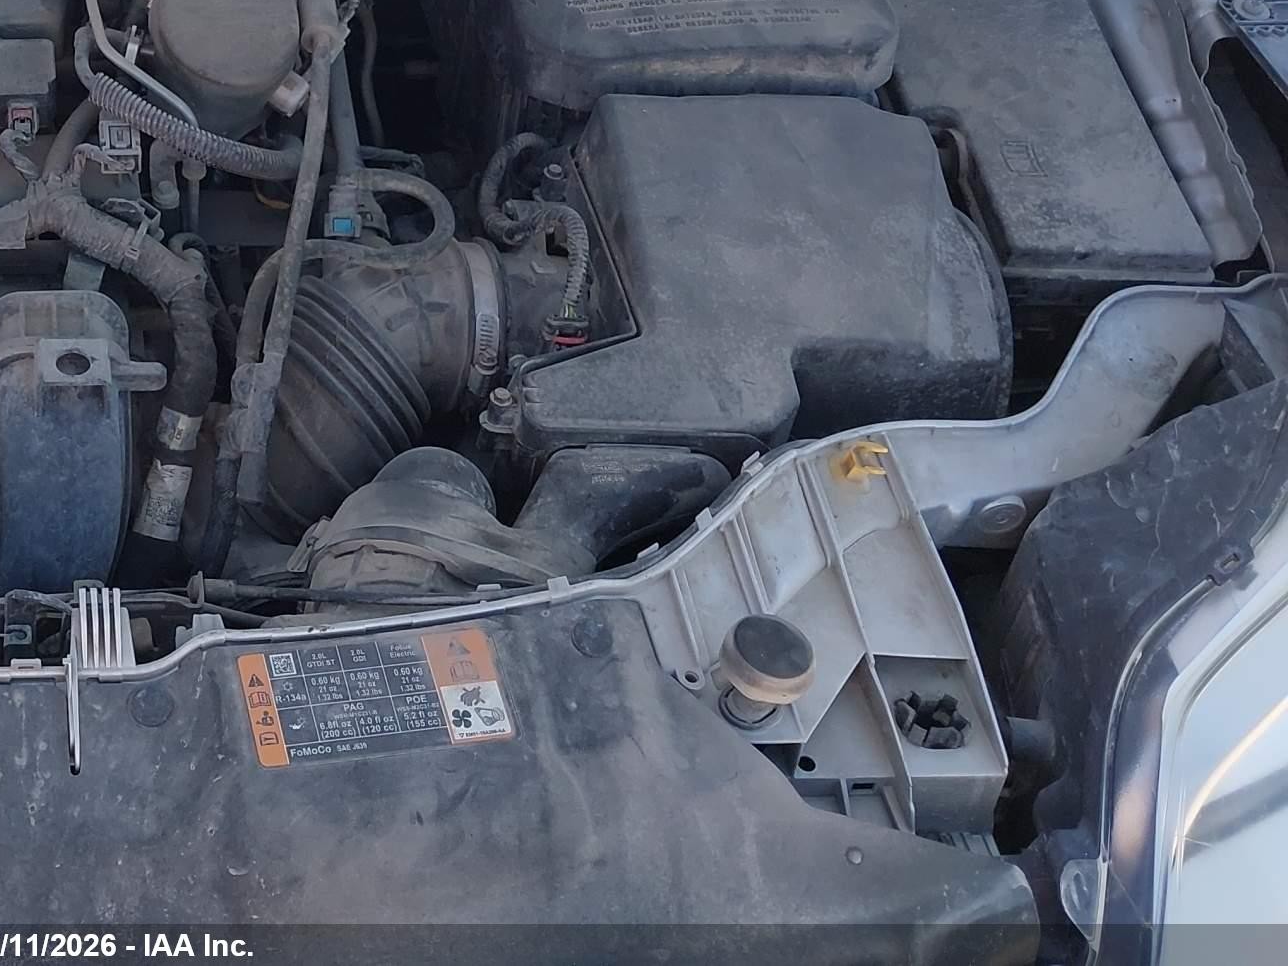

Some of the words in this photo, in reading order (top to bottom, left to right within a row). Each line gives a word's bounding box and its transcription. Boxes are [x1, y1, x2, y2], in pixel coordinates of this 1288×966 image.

[389, 649, 416, 659] Electric
[349, 672, 367, 681] 0.60
[369, 670, 380, 680] kg
[393, 667, 411, 677] 0.60
[412, 666, 424, 675] kg
[311, 676, 328, 686] 0.60
[330, 675, 341, 685] kg
[357, 681, 366, 689] 21
[401, 676, 410, 684] 21
[318, 685, 327, 693] 21
[355, 689, 371, 697] 1.32
[371, 687, 383, 695] lbs
[400, 684, 415, 693] 1.32
[275, 693, 307, 704] R-134a
[317, 693, 332, 702] 1.32
[332, 692, 343, 700] lbs
[405, 694, 428, 705] POE
[343, 701, 365, 712] PAG
[359, 716, 372, 725] 4.0
[383, 715, 395, 723] oz
[403, 712, 417, 721] 5.2
[427, 709, 438, 717] oz
[341, 720, 353, 728] oz
[362, 724, 382, 735] (120
[383, 722, 398, 732] cc)
[406, 718, 426, 731] (155
[427, 717, 442, 728] cc)
[320, 729, 340, 740] (200
[342, 727, 357, 738] cc)
[290, 745, 332, 757] FoMoCo
[336, 743, 353, 752] SAE
